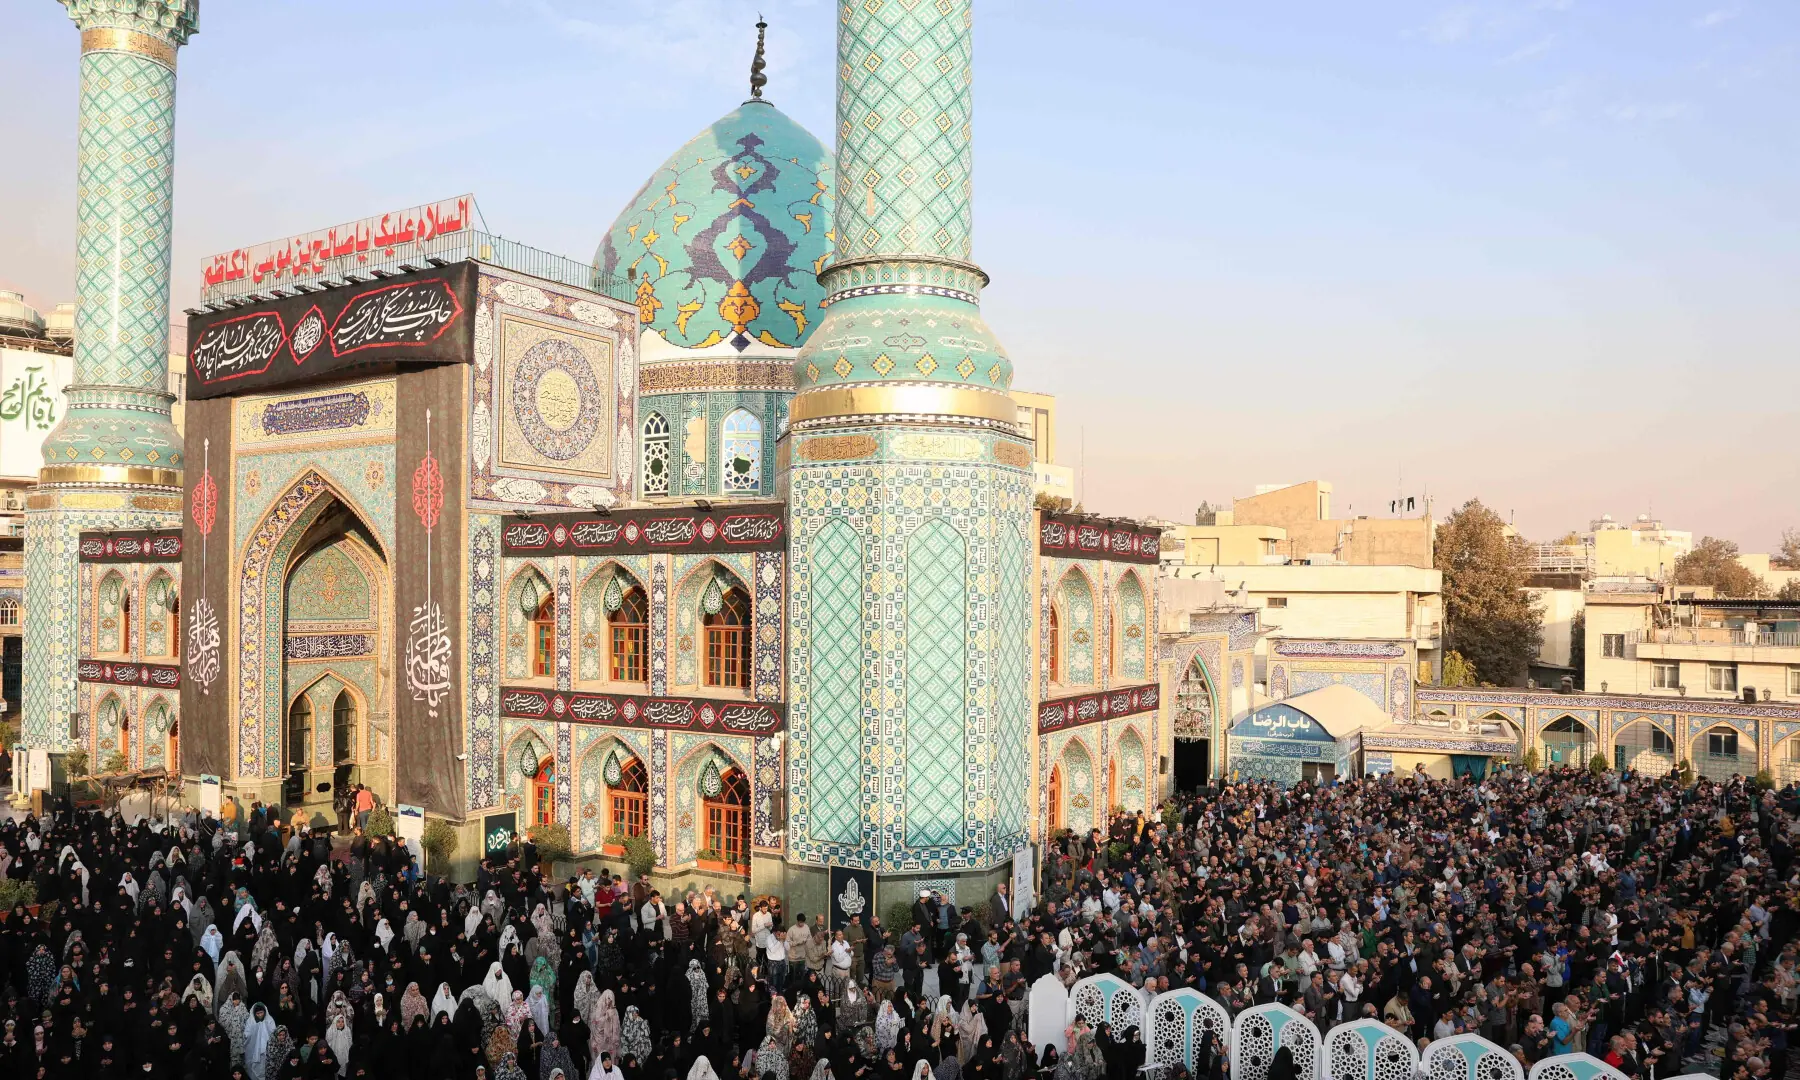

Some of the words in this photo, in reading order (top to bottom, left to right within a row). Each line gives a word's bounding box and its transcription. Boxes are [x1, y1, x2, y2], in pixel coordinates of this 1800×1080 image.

[355, 223, 369, 263] یا
[374, 213, 415, 257] علیک
[416, 197, 469, 249] السلام
[292, 238, 312, 277] بن
[312, 226, 355, 275] صالح
[1252, 714, 1286, 731] الرضا
[1287, 715, 1310, 732] باب
